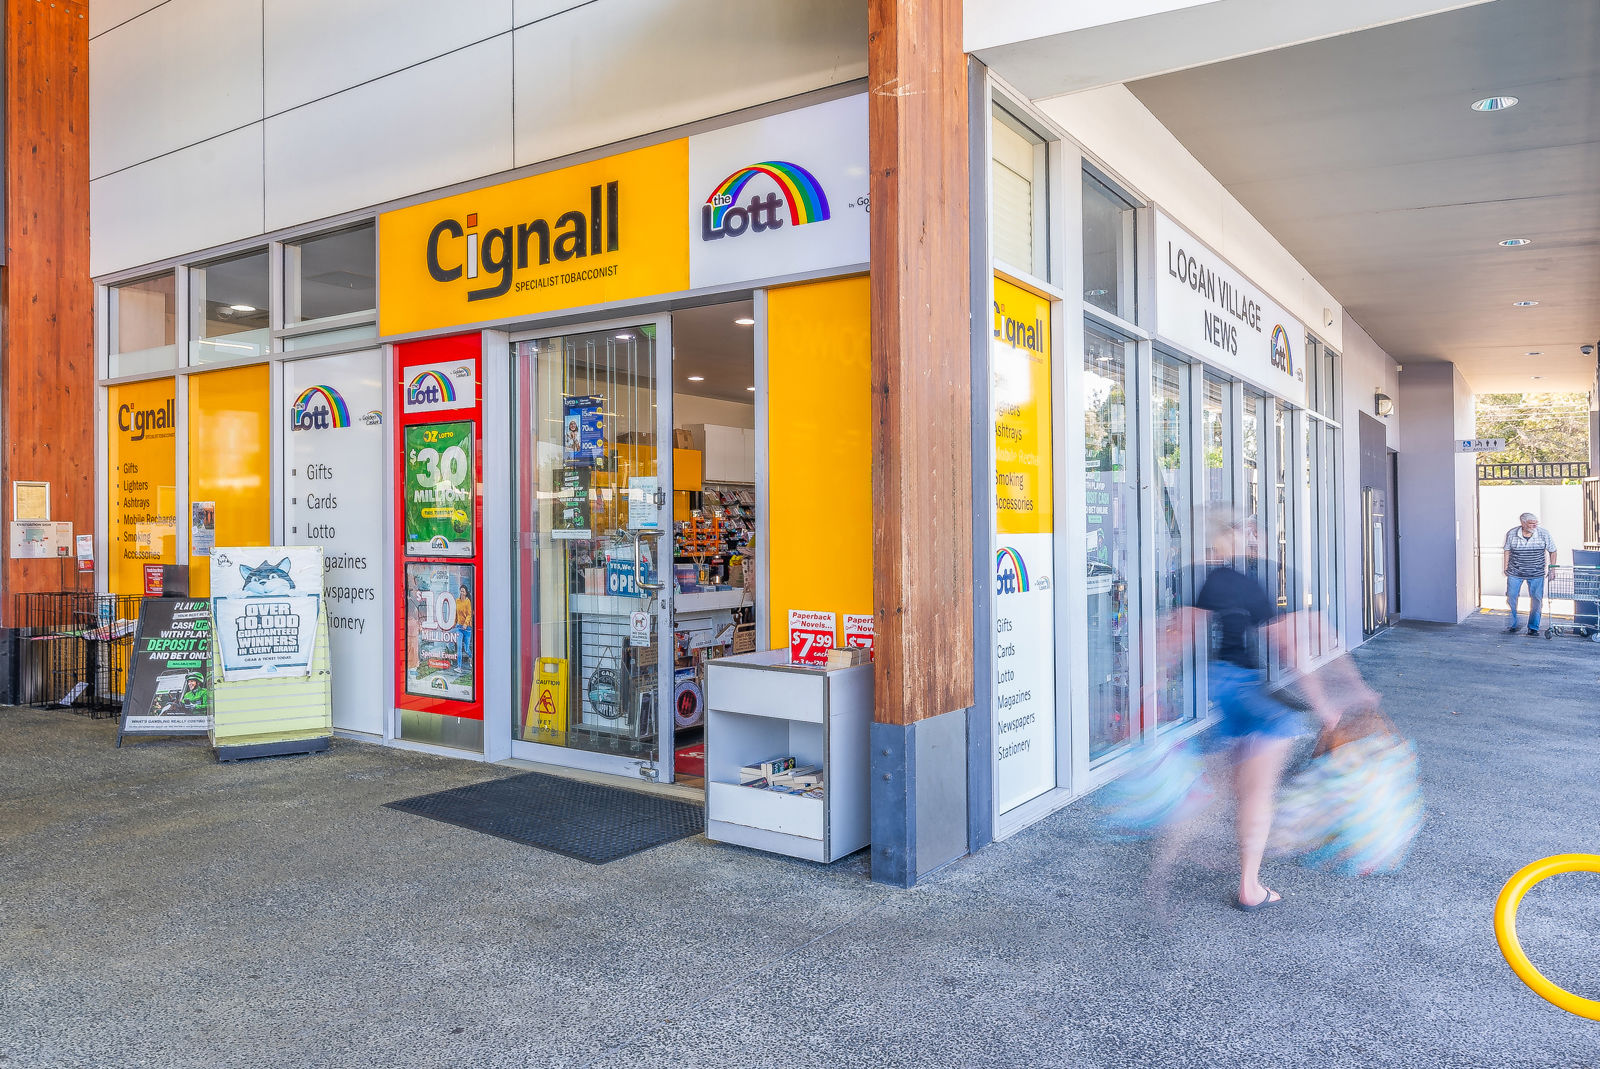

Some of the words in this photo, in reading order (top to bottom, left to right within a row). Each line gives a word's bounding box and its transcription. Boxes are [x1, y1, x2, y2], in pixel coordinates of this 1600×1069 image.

[713, 193, 731, 206] the
[702, 192, 783, 241] Lott
[426, 181, 619, 302] Cignall
[515, 275, 560, 293] SPECIALIST
[561, 264, 619, 285] TOBACCONIST
[1168, 241, 1215, 302] LOGAN
[1218, 276, 1262, 333] VILLAGE
[1204, 309, 1238, 356] NEWS
[407, 385, 439, 405] Lott
[998, 403, 1021, 417] ghters
[118, 399, 175, 441] Cignall
[291, 405, 329, 431] Lott
[423, 430, 439, 443] OZ
[438, 431, 454, 440] LOTTO
[123, 462, 139, 474] Gifts
[307, 463, 333, 480] Gifts
[123, 480, 149, 493] Lighters
[123, 497, 151, 510] Ashtrays
[307, 493, 338, 510] Cards
[124, 513, 146, 526] Mobile
[146, 513, 176, 527] Recharge
[307, 522, 336, 539] Lotto
[123, 531, 152, 545] Smoking
[123, 548, 161, 560] Accessories
[324, 553, 367, 573] gazines
[610, 573, 645, 594] OPEN
[997, 568, 1015, 595] ott
[324, 586, 375, 604] wspapers
[246, 603, 290, 617] OVER
[792, 611, 832, 621] Paperback
[171, 621, 194, 630] CASH
[329, 611, 365, 634] ionery
[847, 616, 874, 624] Paperb
[997, 618, 1013, 633] Gifts
[160, 630, 184, 638] WITH
[184, 630, 208, 638] PLAY
[237, 628, 298, 638] GUARANTEED
[147, 639, 197, 651] DEPOSIT
[239, 636, 297, 648] WINNERS
[791, 630, 832, 657] $7.99
[149, 652, 170, 660] AND
[170, 652, 189, 660] BET
[249, 647, 271, 655] EVERY
[273, 645, 298, 653] DRAW!
[420, 649, 441, 660] Special
[441, 652, 458, 661] Event
[813, 649, 828, 658] each
[997, 642, 1016, 659] Cards
[997, 670, 1014, 684] Lotto
[998, 689, 1032, 710] Magazines
[998, 712, 1036, 735] Newspapers
[998, 738, 1031, 761] Stationery
